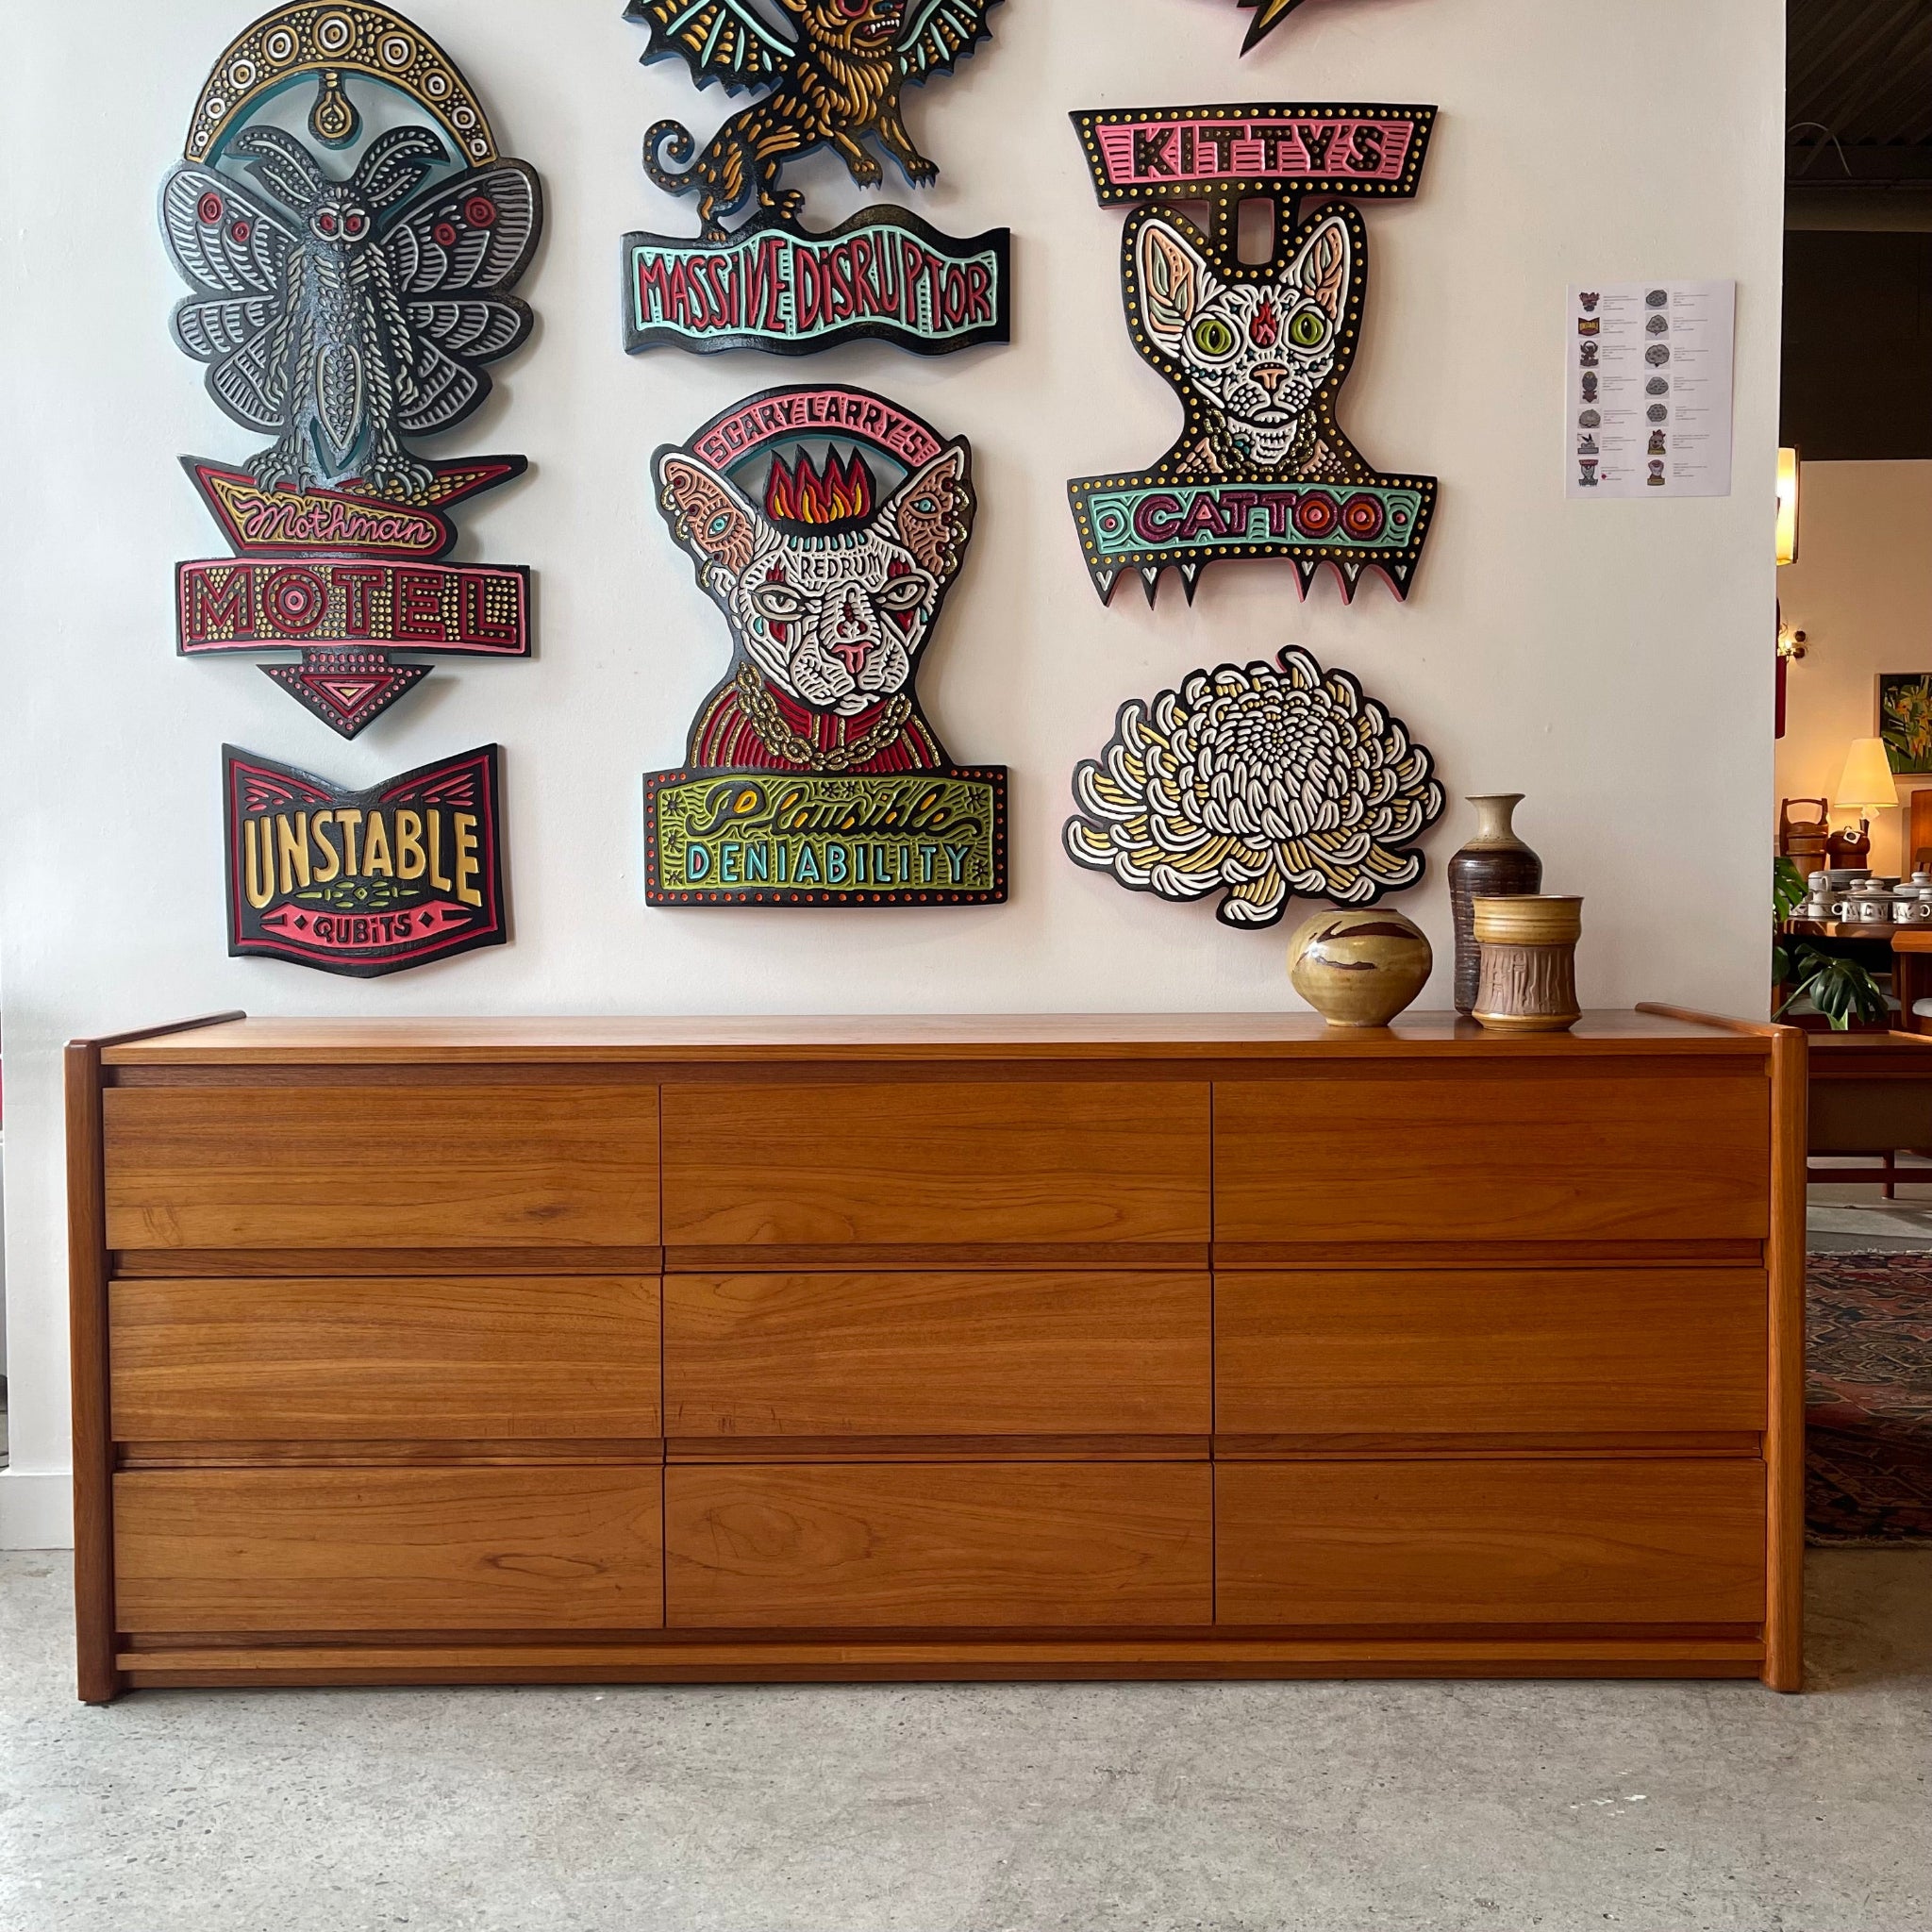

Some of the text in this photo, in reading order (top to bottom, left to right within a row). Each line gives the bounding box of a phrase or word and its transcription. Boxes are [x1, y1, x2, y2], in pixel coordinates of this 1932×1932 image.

[704, 396, 799, 463] SCARY
[233, 499, 433, 543] Mothman
[1135, 492, 1386, 541] CATTOO
[801, 552, 884, 580] REDRUM
[189, 567, 516, 644] MOTEL
[243, 808, 483, 909] UNSTABLE
[688, 844, 969, 883] DENIABILITY
